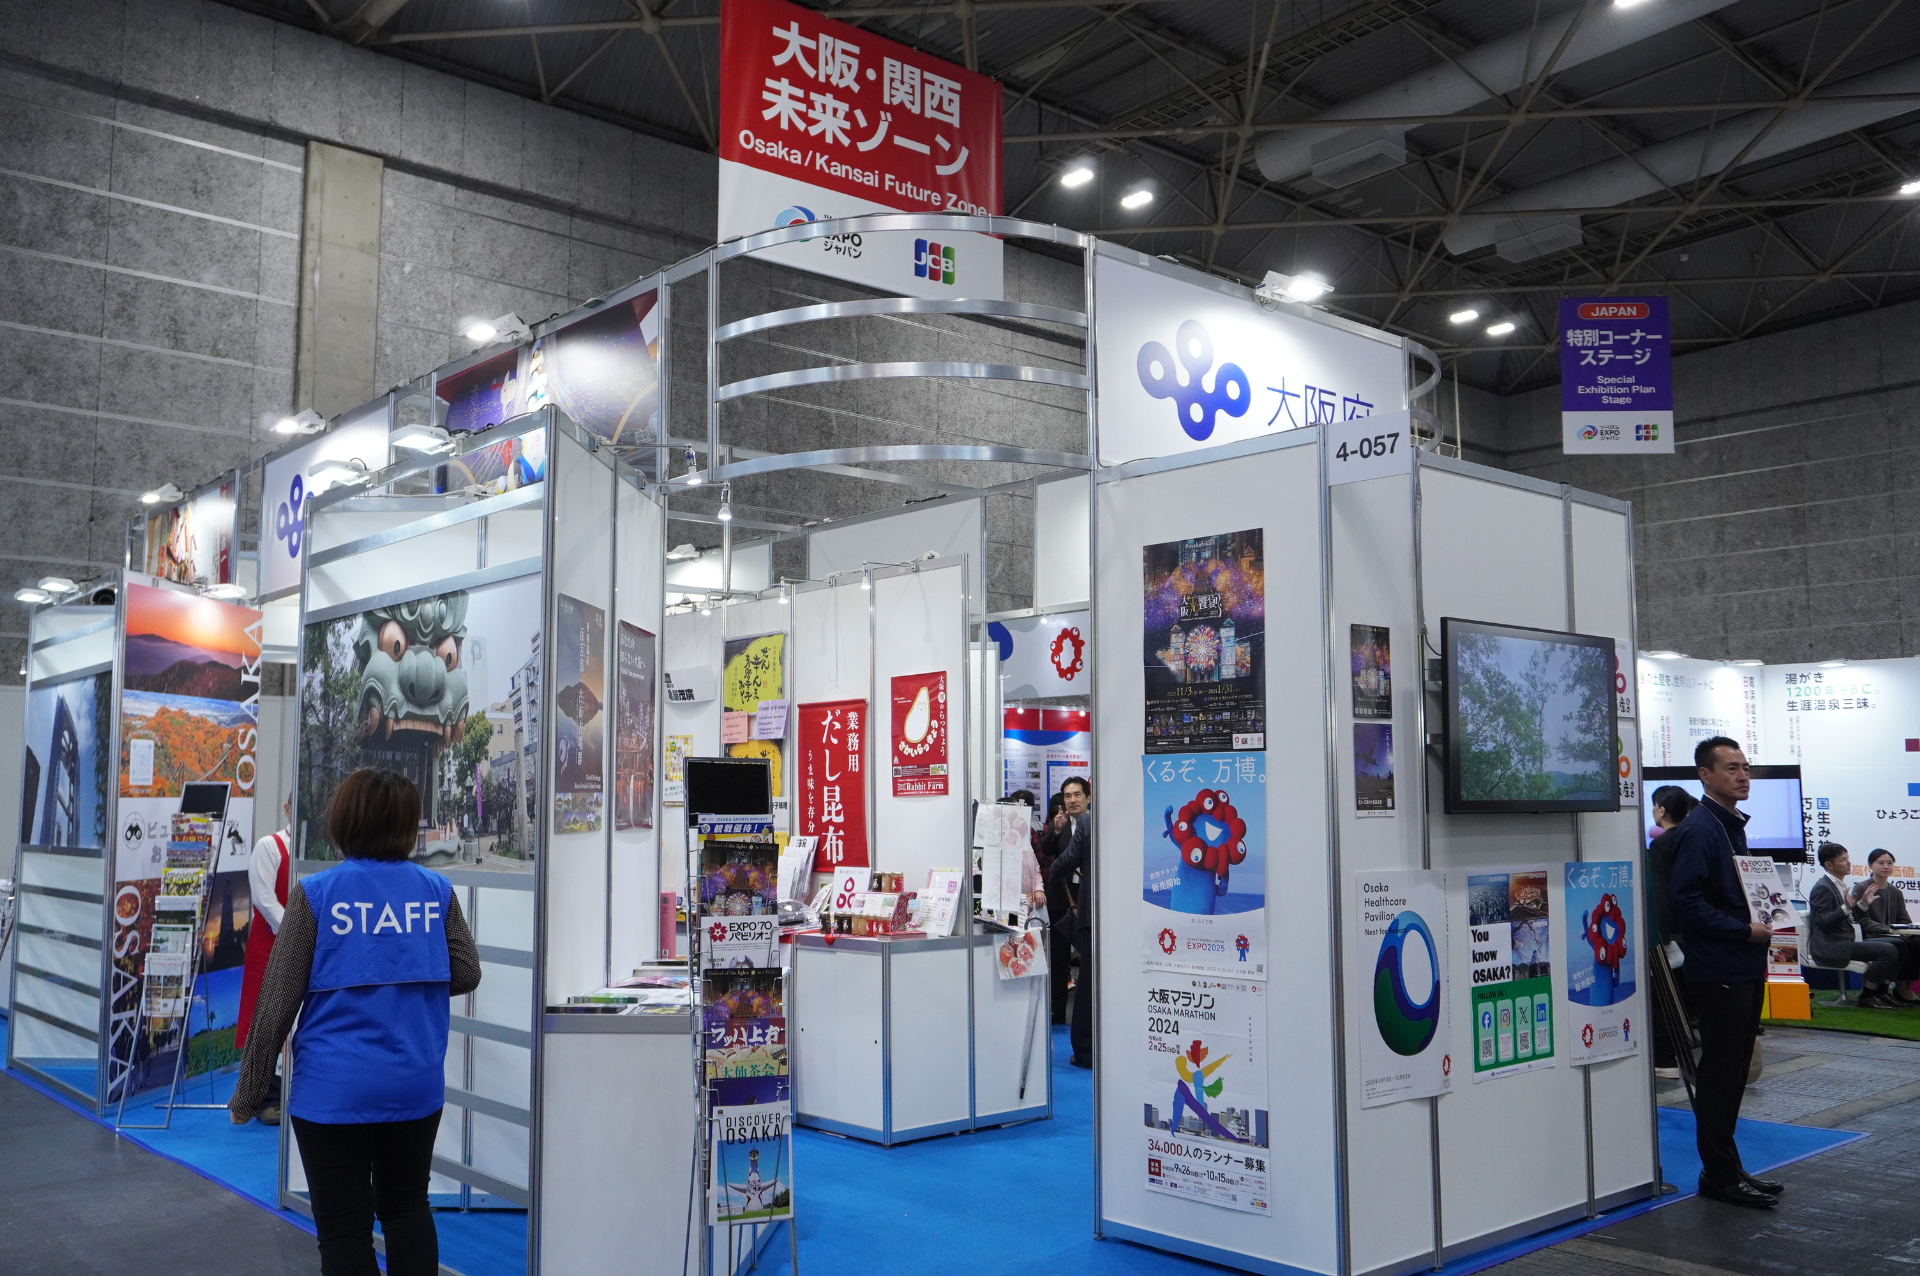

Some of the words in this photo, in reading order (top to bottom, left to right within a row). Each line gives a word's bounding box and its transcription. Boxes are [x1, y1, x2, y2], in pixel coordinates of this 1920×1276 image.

[772, 20, 961, 128] 大阪・関西
[761, 77, 969, 176] 未来ゾーン
[739, 129, 802, 166] Osaka
[815, 152, 879, 189] Kansai
[884, 174, 942, 207] Future
[946, 192, 987, 217] Zone
[823, 240, 862, 259] ジャパン
[914, 245, 955, 279] JCB
[1591, 306, 1636, 317] JAPAN
[1567, 329, 1662, 346] 特別コーナー
[1580, 348, 1651, 365] ステージ
[1597, 375, 1635, 385] Special
[1578, 385, 1629, 394] Exhibition
[1632, 385, 1655, 394] Plan
[1602, 395, 1632, 404] Stage
[1636, 426, 1659, 439] JCB
[1336, 432, 1400, 463] 4-057
[1785, 672, 1824, 685] 湯がき
[236, 618, 263, 791] OSAKA
[1786, 697, 1877, 712] 生涯温泉三昧。
[846, 711, 859, 772] 業務用
[1147, 756, 1266, 784] くるぞ、万博。
[821, 709, 845, 865] だし昆布
[906, 782, 926, 791] Rabbit
[927, 781, 944, 790] Farm
[1567, 864, 1634, 889] くるぞ、万博。
[1364, 883, 1389, 893] Osaka
[1364, 897, 1407, 908] Healthcare
[331, 901, 440, 935] STAFF
[1365, 912, 1395, 922] Pavilion
[728, 931, 772, 941] パビリオン
[1379, 928, 1387, 936] for
[1471, 929, 1489, 943] You
[1187, 942, 1225, 952] EXPO2025
[1472, 950, 1497, 963] know
[1473, 965, 1511, 983] OSAKA?
[108, 885, 142, 1104] OSAKA
[1148, 988, 1215, 1010] 大阪マラソン
[1478, 991, 1497, 1000] FOLLOW
[1497, 989, 1504, 997] US
[1148, 1005, 1172, 1016] OSAKA
[1173, 1008, 1216, 1021] MARATHON
[1148, 1017, 1179, 1036] 2024
[711, 1024, 780, 1046] ワッハ上方
[723, 1063, 775, 1078] 大仙茶会
[726, 1112, 781, 1128] DISCOVER
[726, 1124, 780, 1145] OSAKA
